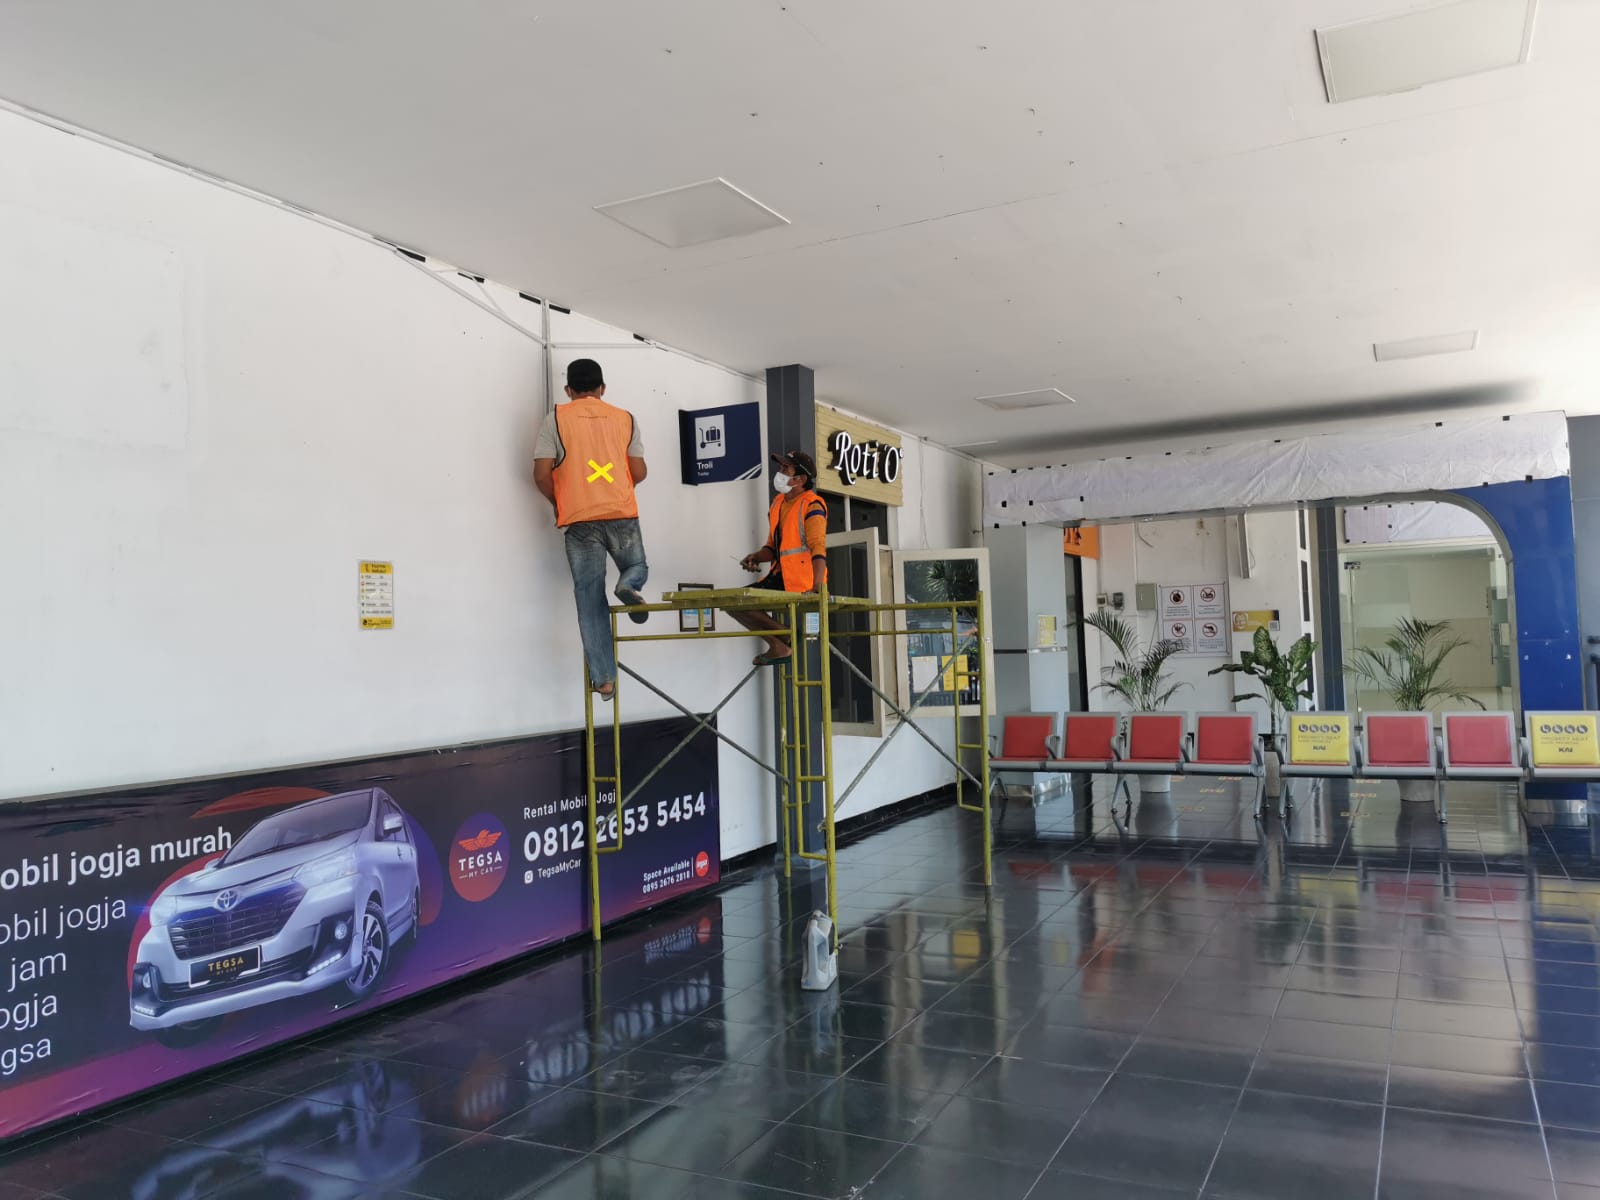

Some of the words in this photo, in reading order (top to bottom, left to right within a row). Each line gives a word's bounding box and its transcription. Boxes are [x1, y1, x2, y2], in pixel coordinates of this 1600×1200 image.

[523, 801, 557, 820] Rental
[560, 794, 588, 812] Mobil
[596, 788, 617, 805] Jogj
[523, 820, 585, 862] 0812
[595, 804, 649, 844] 2653
[656, 791, 706, 827] 5454
[67, 843, 142, 886] jogja
[150, 826, 232, 864] murah
[458, 850, 503, 872] TEGSA
[537, 858, 582, 879] TegsaMyCar
[643, 870, 662, 882] Space
[663, 859, 690, 875] Available
[642, 880, 659, 894] 0895
[56, 896, 126, 939] jogja
[8, 952, 67, 992] jam
[207, 956, 245, 973] TEGSA
